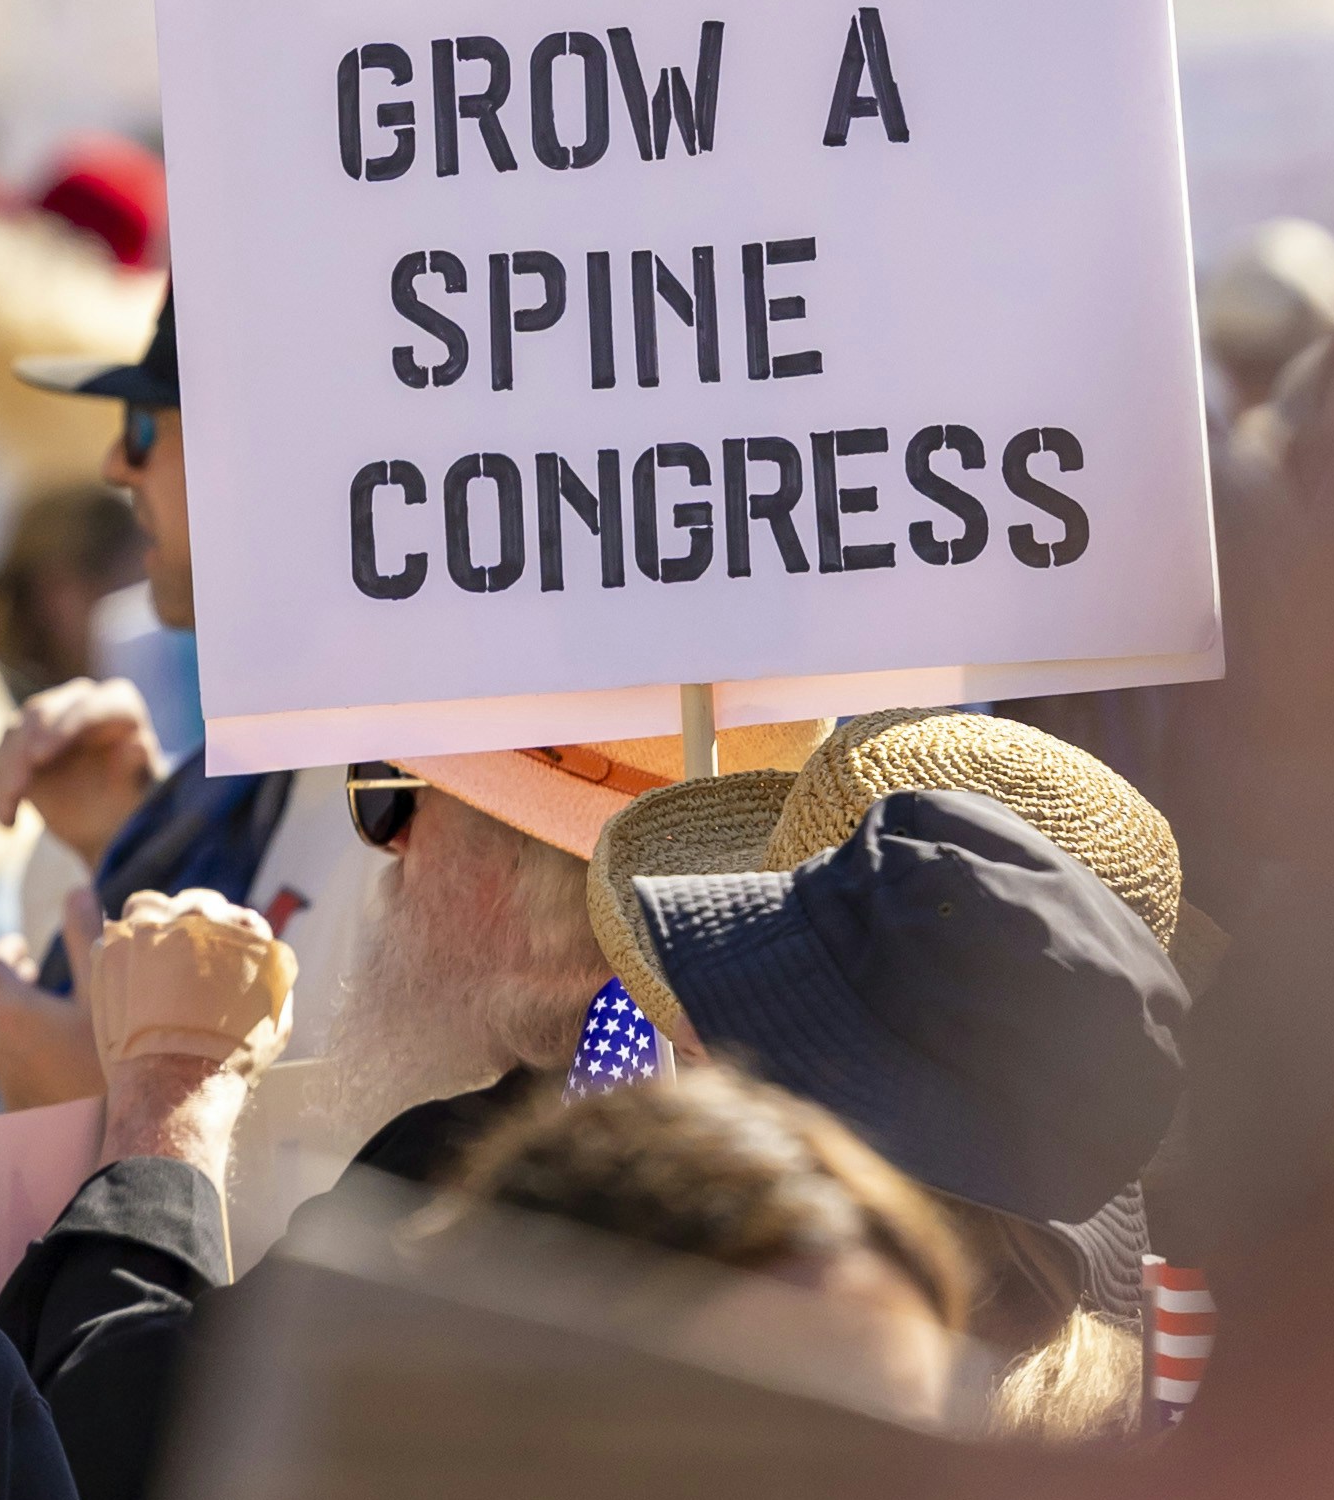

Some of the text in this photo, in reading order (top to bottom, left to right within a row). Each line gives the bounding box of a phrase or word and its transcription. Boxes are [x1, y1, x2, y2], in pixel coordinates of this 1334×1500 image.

[337, 6, 911, 183] GROW A
[390, 236, 824, 392] SPINE
[349, 424, 1090, 602] CONGRESS
